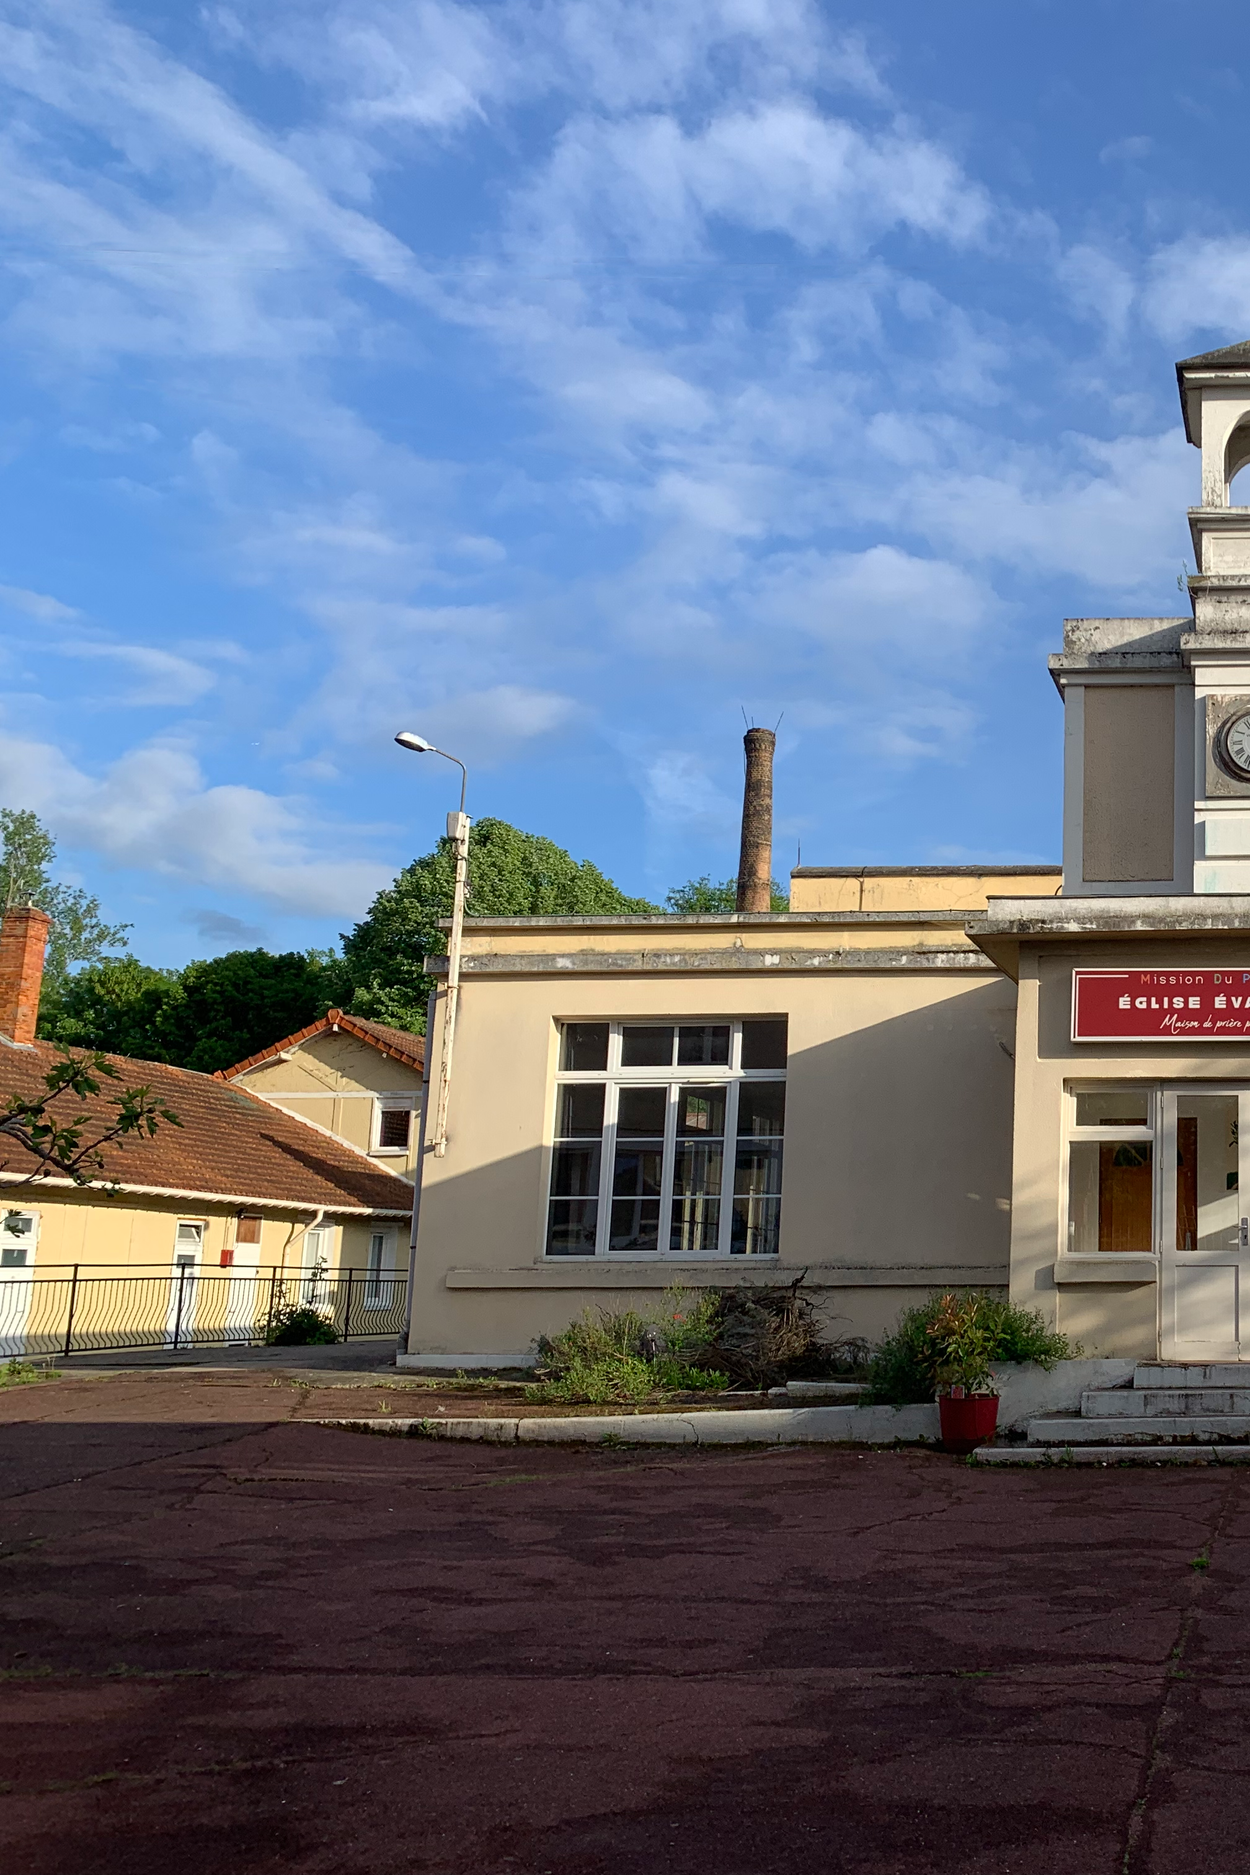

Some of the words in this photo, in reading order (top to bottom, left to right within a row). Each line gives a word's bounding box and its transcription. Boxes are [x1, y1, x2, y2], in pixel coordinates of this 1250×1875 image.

[1140, 973, 1204, 985] Mission
[1213, 973, 1233, 985] Du
[1118, 993, 1201, 1009] ÉGLISE
[1159, 1013, 1200, 1035] Maison
[1202, 1013, 1213, 1028] de
[1213, 1017, 1243, 1032] prière
